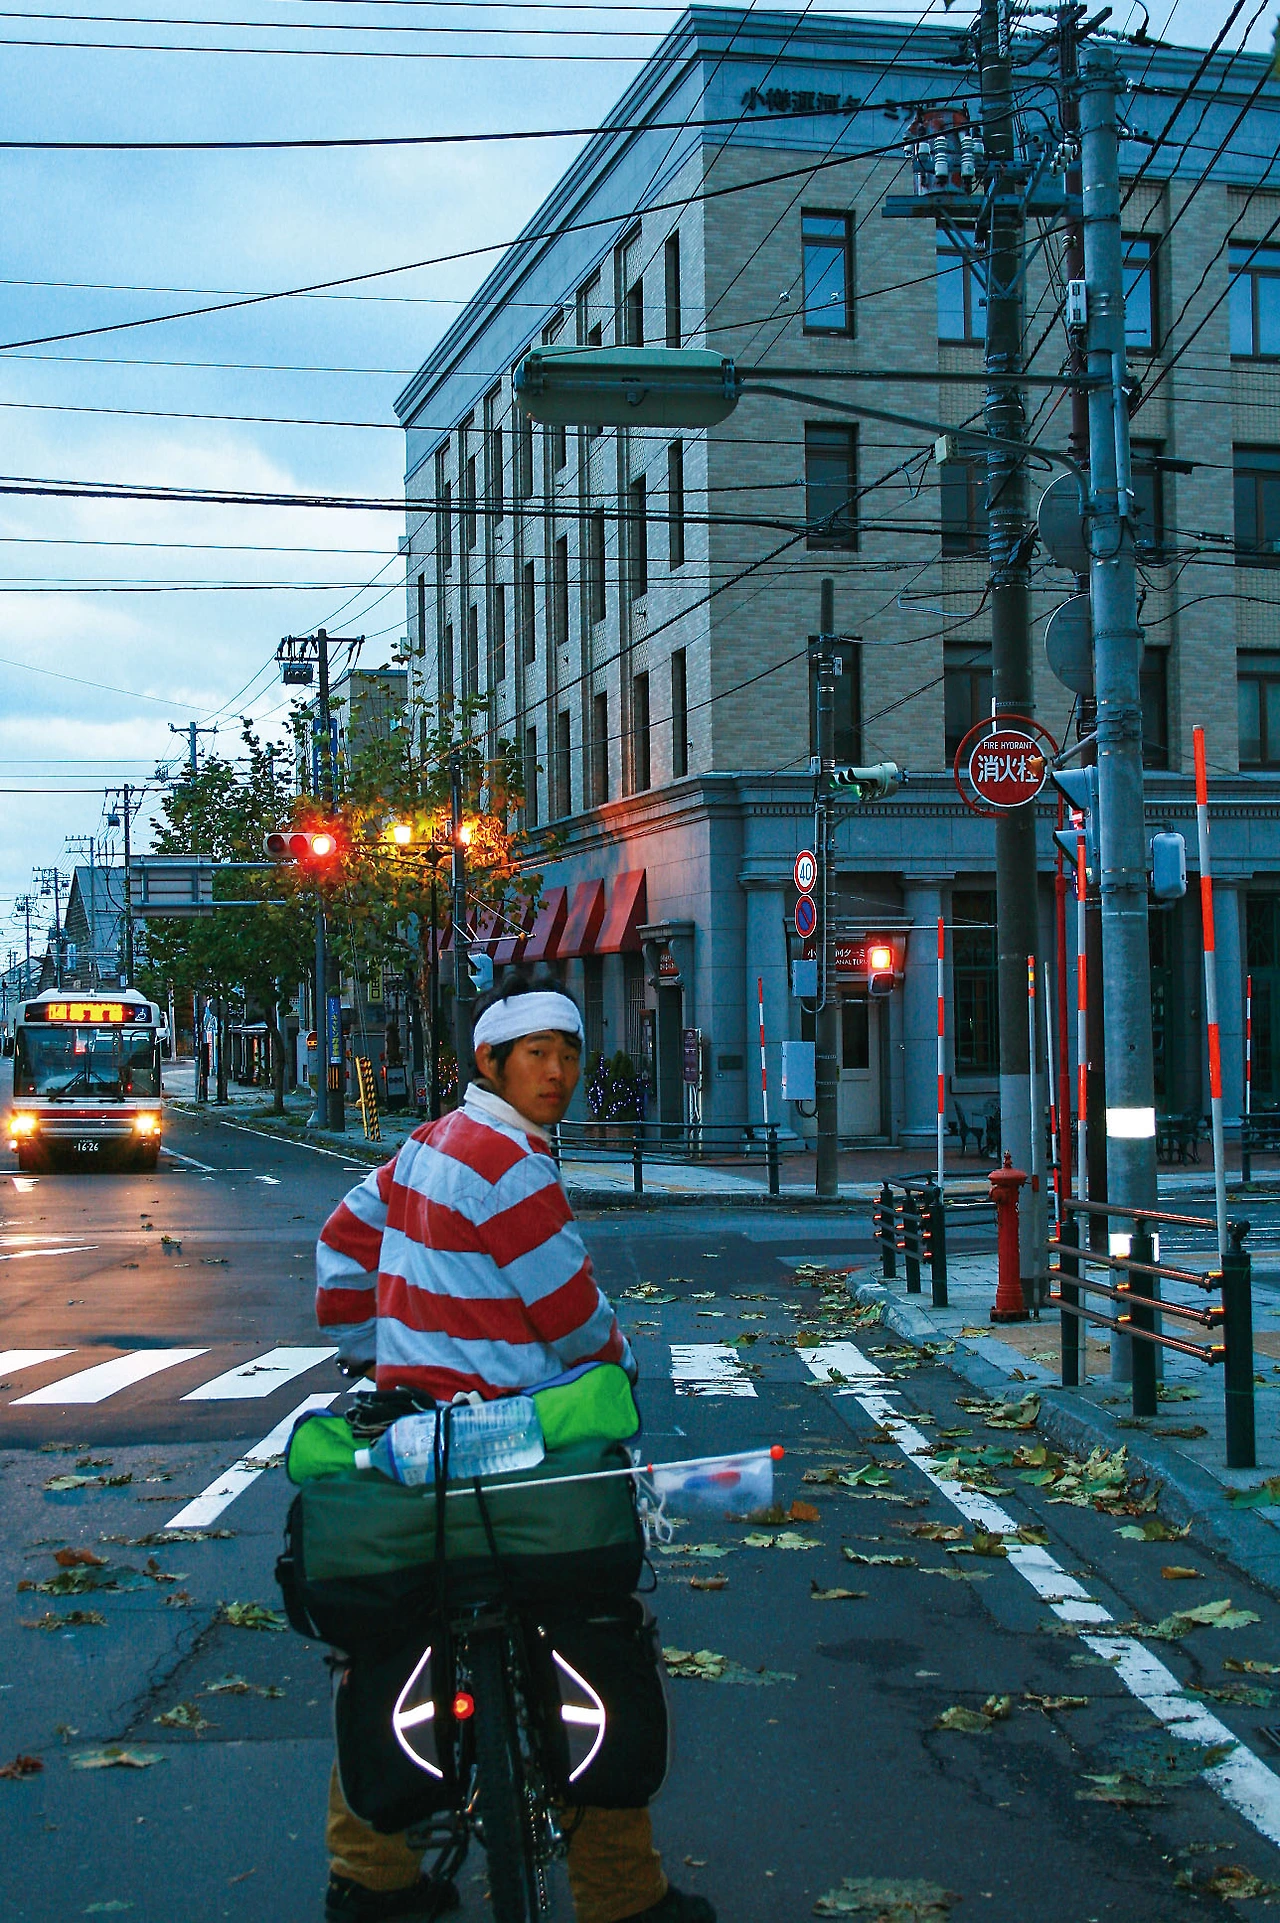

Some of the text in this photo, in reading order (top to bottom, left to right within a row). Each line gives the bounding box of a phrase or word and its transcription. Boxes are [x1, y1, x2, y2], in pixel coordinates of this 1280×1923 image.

[983, 741, 1034, 750] FIRE HYDRANT
[977, 754, 1039, 783] 消火栓
[799, 863, 812, 881] 40
[77, 1142, 99, 1152] 16-26
